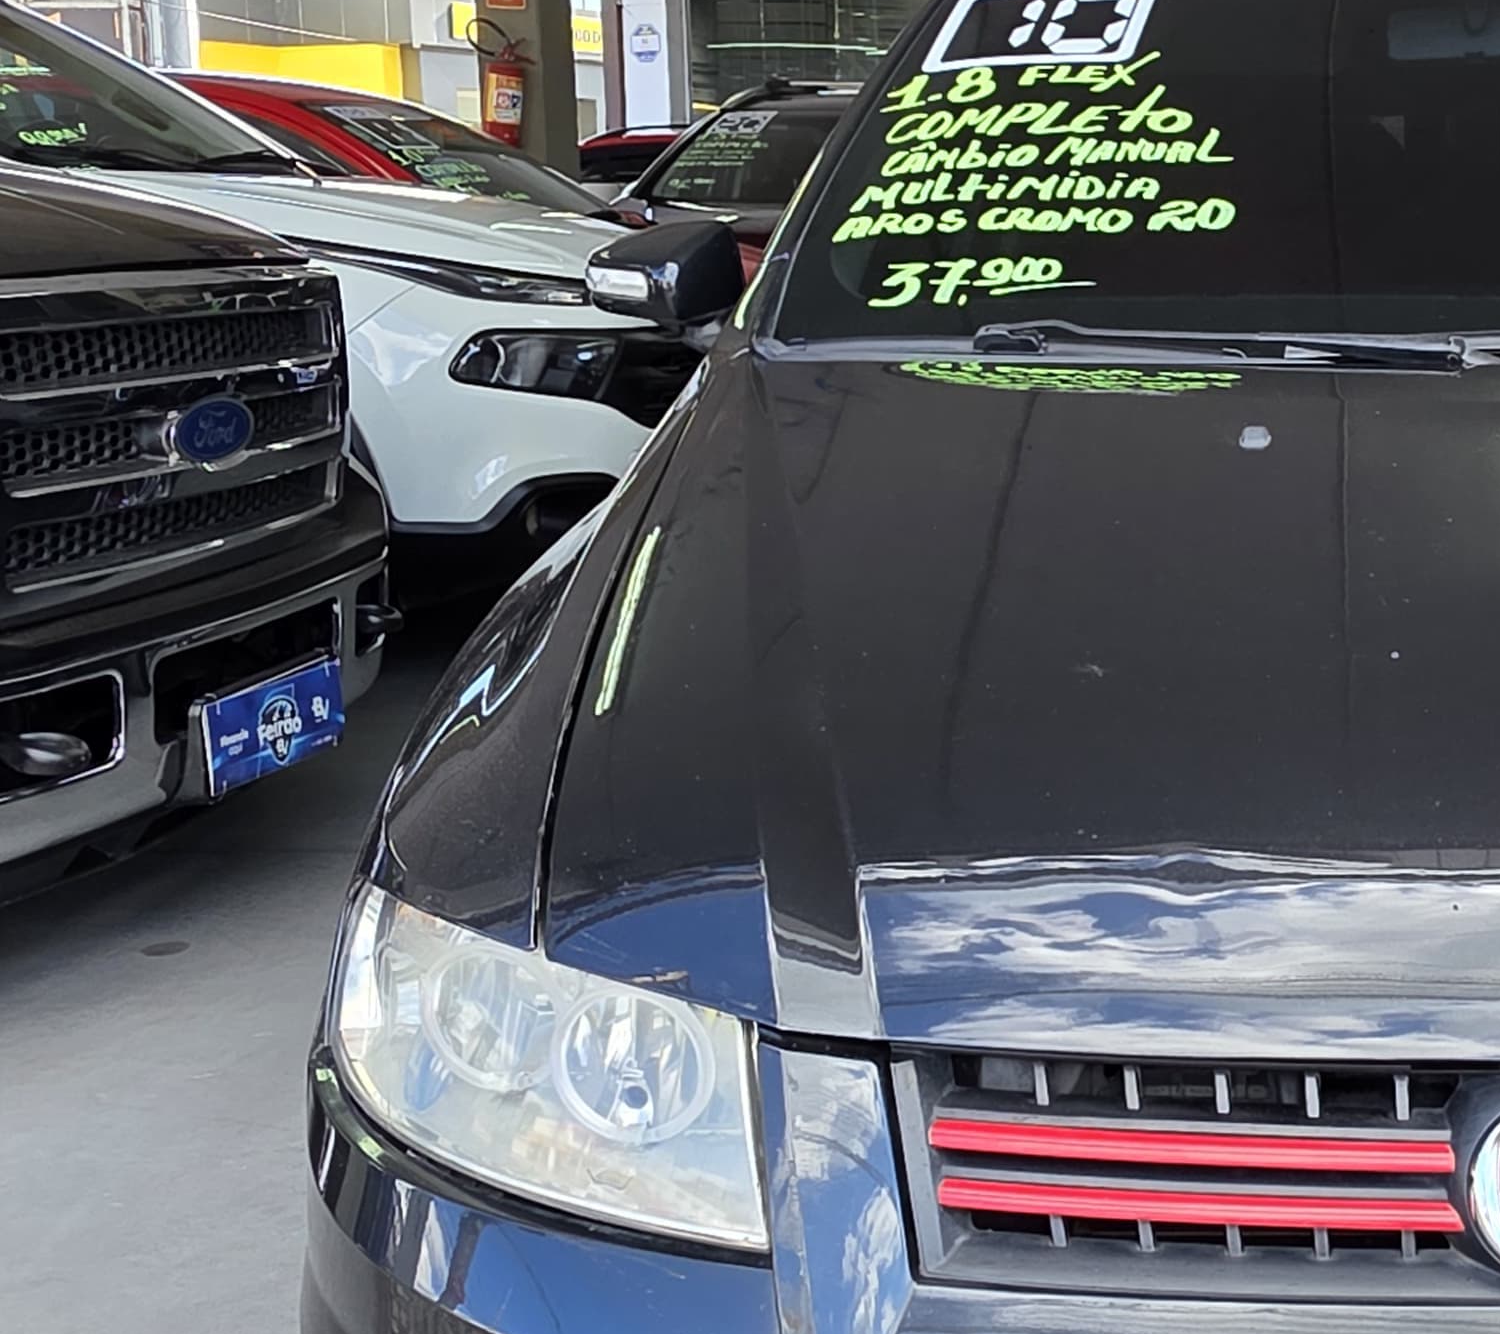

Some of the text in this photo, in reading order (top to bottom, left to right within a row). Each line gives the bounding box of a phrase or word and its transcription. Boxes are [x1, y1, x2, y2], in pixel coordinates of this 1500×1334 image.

[1018, 51, 1161, 92] FLEX
[1044, 127, 1235, 167] MANUAL
[832, 208, 968, 243] AROS
[977, 206, 1134, 234] CROMO
[194, 410, 237, 448] Ford
